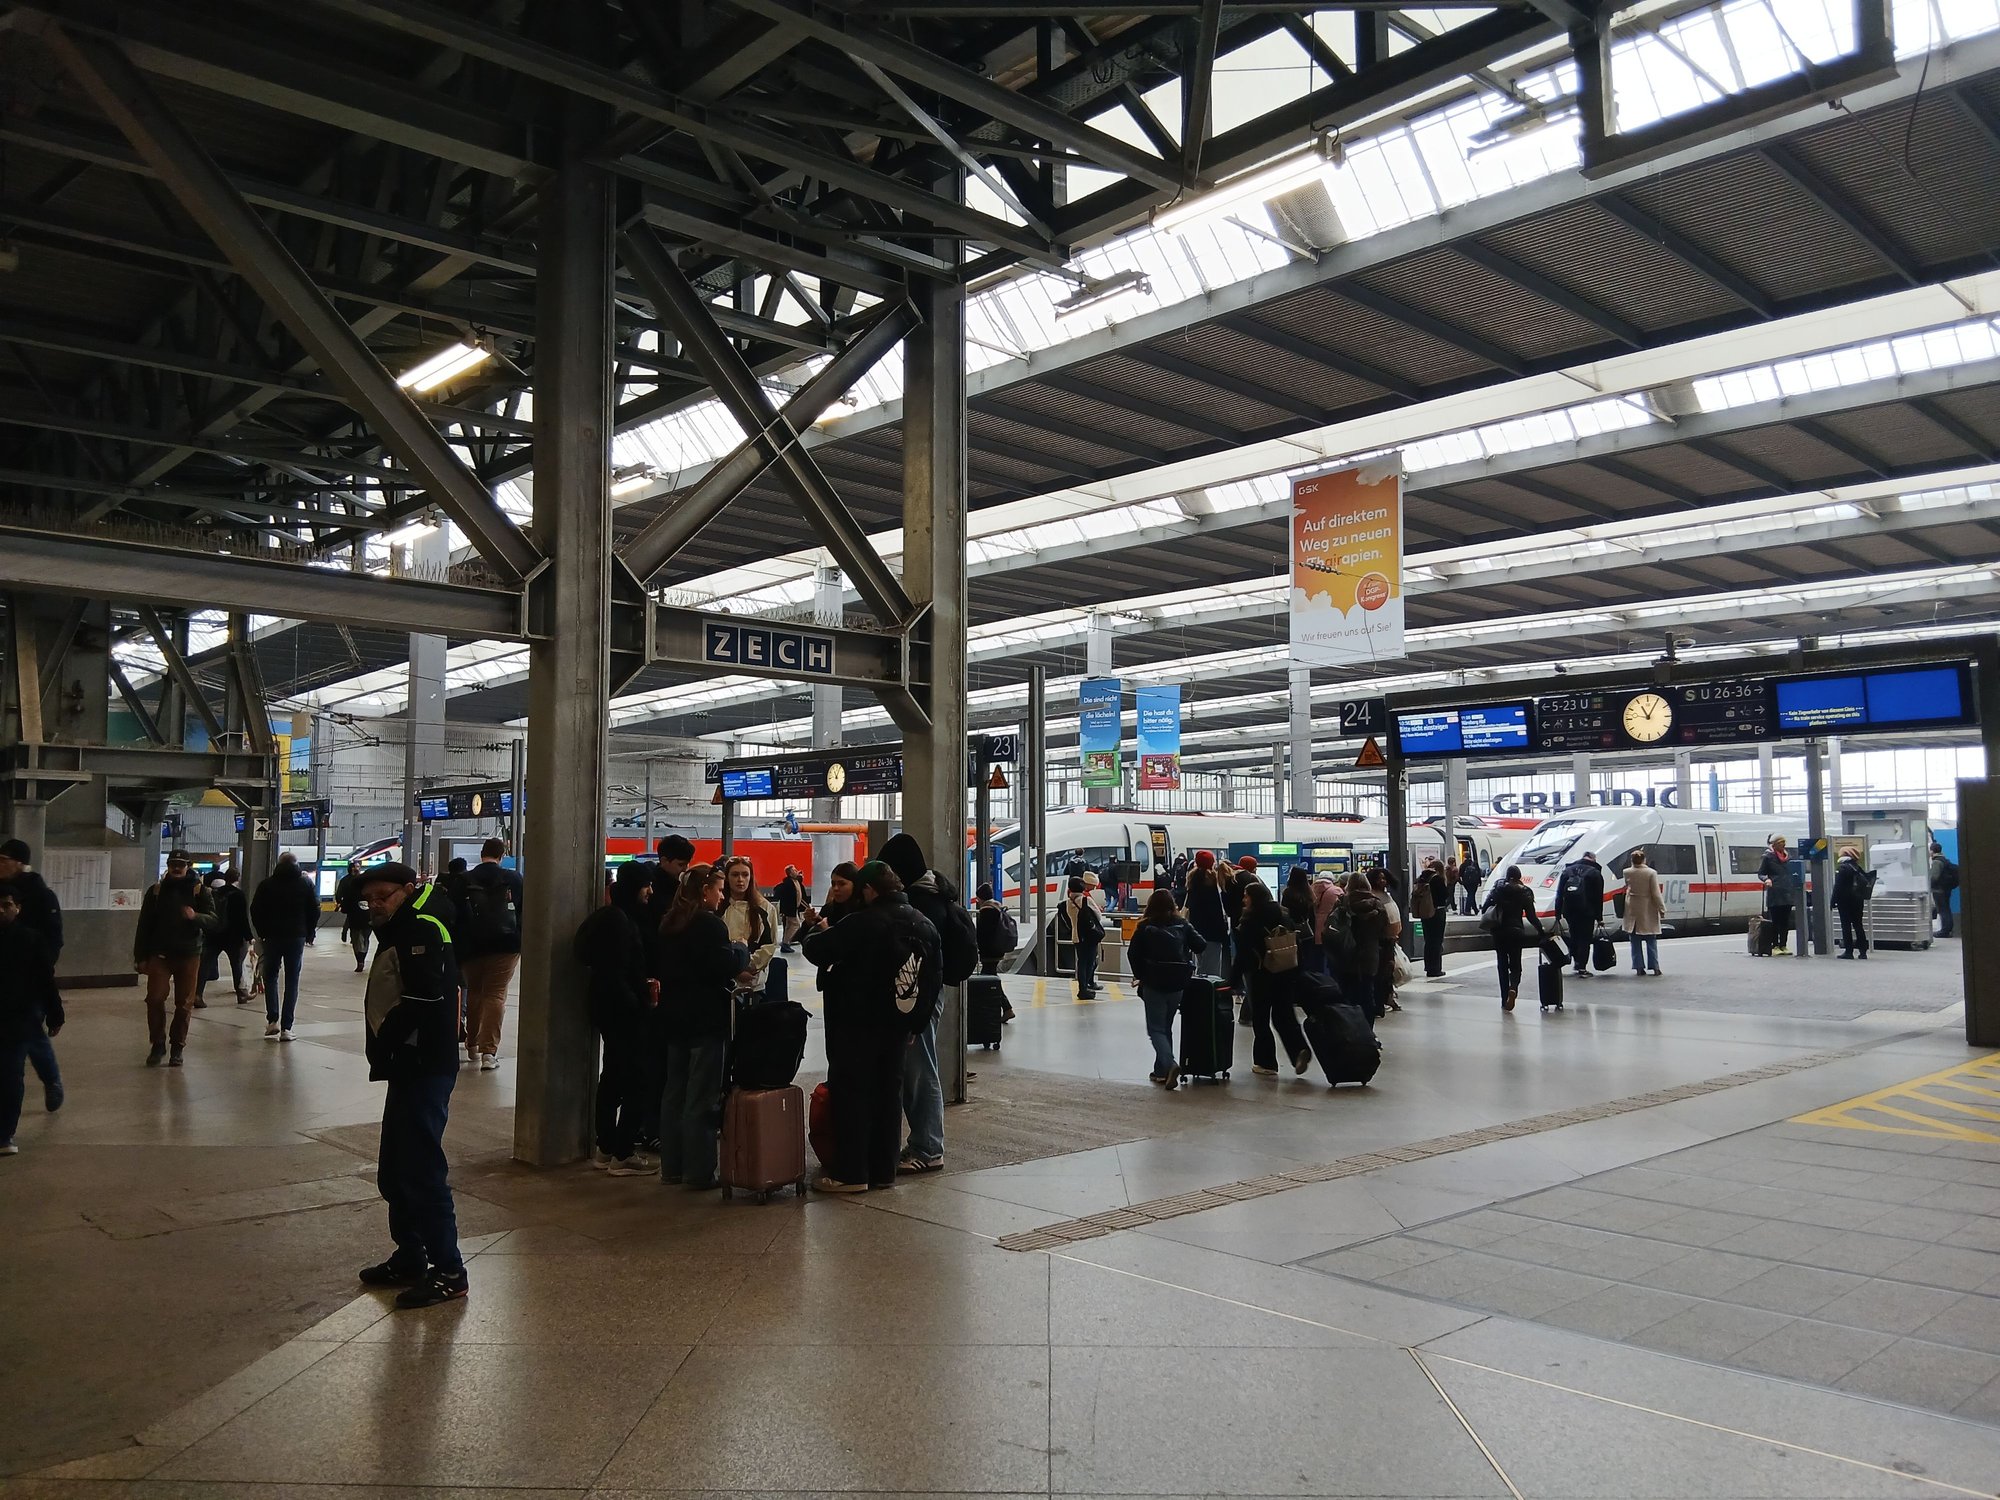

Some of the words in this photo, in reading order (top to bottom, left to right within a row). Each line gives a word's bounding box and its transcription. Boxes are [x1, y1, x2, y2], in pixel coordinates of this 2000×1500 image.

[1298, 484, 1319, 495] GSK
[1303, 516, 1326, 533] Auf
[1328, 508, 1388, 528] direktem
[1300, 539, 1330, 553] Weg
[1333, 536, 1347, 547] zu
[1350, 527, 1392, 544] neuen
[1301, 632, 1315, 642] Wir
[1316, 630, 1343, 641] freuen
[1344, 629, 1359, 637] uns
[1361, 625, 1375, 635] auf
[1376, 622, 1392, 632] Sie!
[713, 630, 828, 669] ZECH
[1083, 696, 1093, 704] Die
[1701, 688, 1710, 700] U
[1714, 685, 1752, 699] 26-36
[1344, 701, 1372, 727] 24
[1552, 700, 1577, 712] 5-23
[1580, 699, 1589, 710] U
[1399, 725, 1413, 733] Bitte
[1423, 723, 1449, 732] einsteigen
[993, 736, 1011, 756] 23
[706, 763, 719, 779] 22
[878, 758, 893, 766] 24-36
[1664, 880, 1687, 904] ICE
